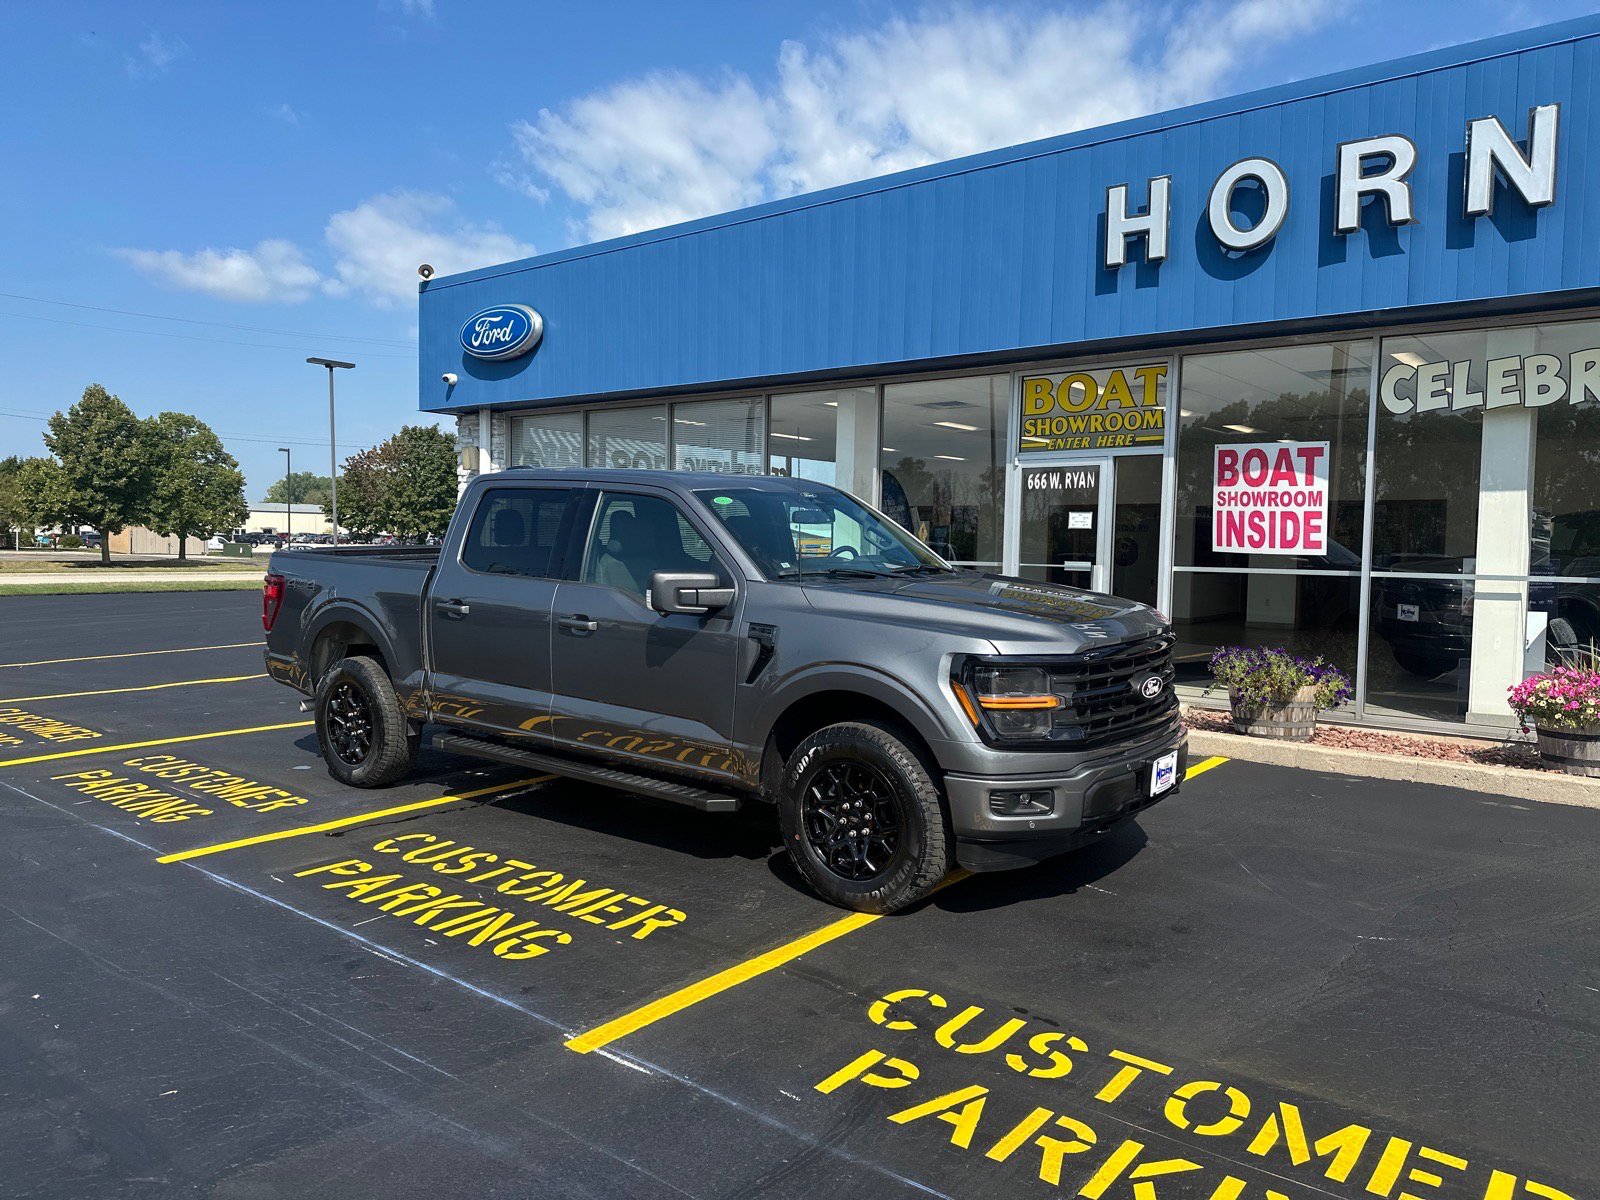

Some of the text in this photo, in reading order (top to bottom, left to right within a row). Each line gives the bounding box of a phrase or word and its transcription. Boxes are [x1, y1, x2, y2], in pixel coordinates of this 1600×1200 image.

[1104, 103, 1562, 270] HORN
[471, 315, 515, 347] Ford
[1023, 366, 1168, 416] BOAT
[1380, 347, 1600, 415] CELEBR
[1023, 409, 1165, 437] SHOWROOM
[1047, 433, 1136, 450] ENTER HERE
[1027, 471, 1095, 490] 666 W. RYAN
[1217, 447, 1324, 488] BOAT
[1217, 491, 1323, 507] SHOWROOM
[1216, 510, 1323, 549] INSIDE
[51, 769, 214, 823] PARKING
[123, 755, 309, 813] CUSTOMER
[294, 858, 572, 960] PARKING
[373, 833, 687, 940] CUSTOMER
[815, 1048, 1290, 1200] PARK
